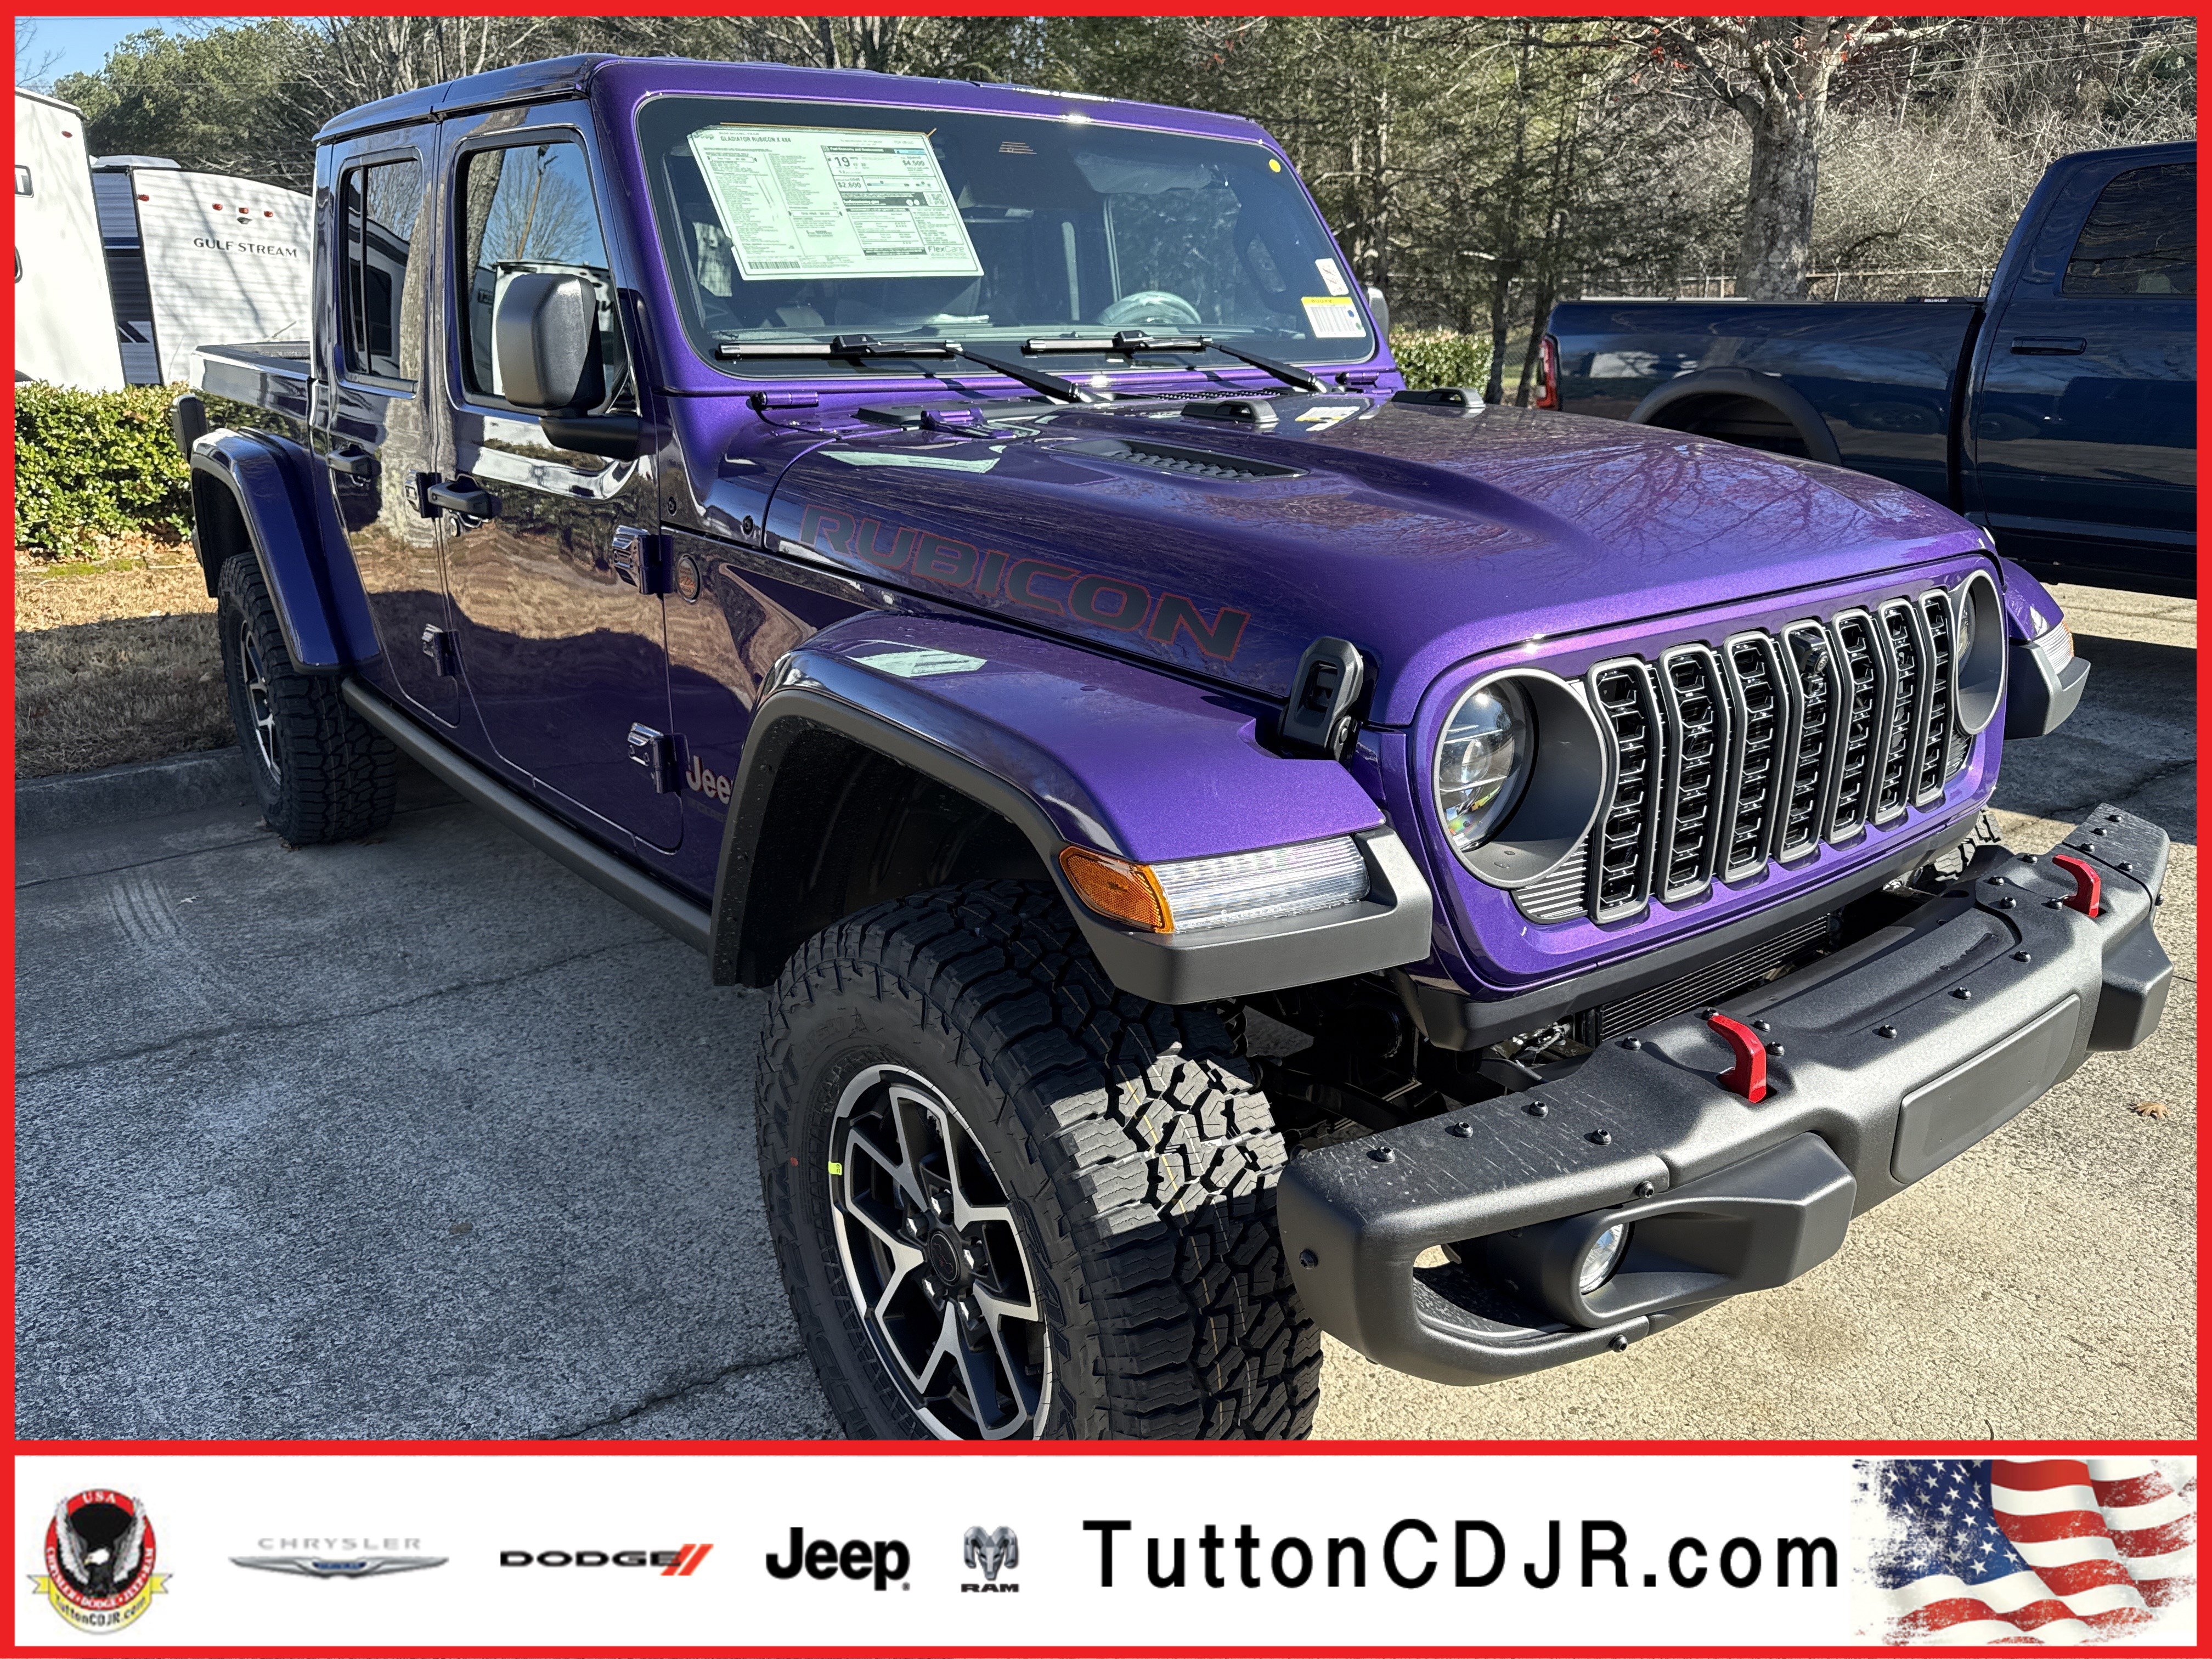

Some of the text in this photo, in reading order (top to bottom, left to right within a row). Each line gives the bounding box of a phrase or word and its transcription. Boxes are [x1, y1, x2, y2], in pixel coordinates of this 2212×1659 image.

[834, 156, 850, 167] 19
[193, 238, 297, 258] GULF STREAM
[799, 504, 1251, 662] RUBICON
[686, 755, 733, 805] Jee
